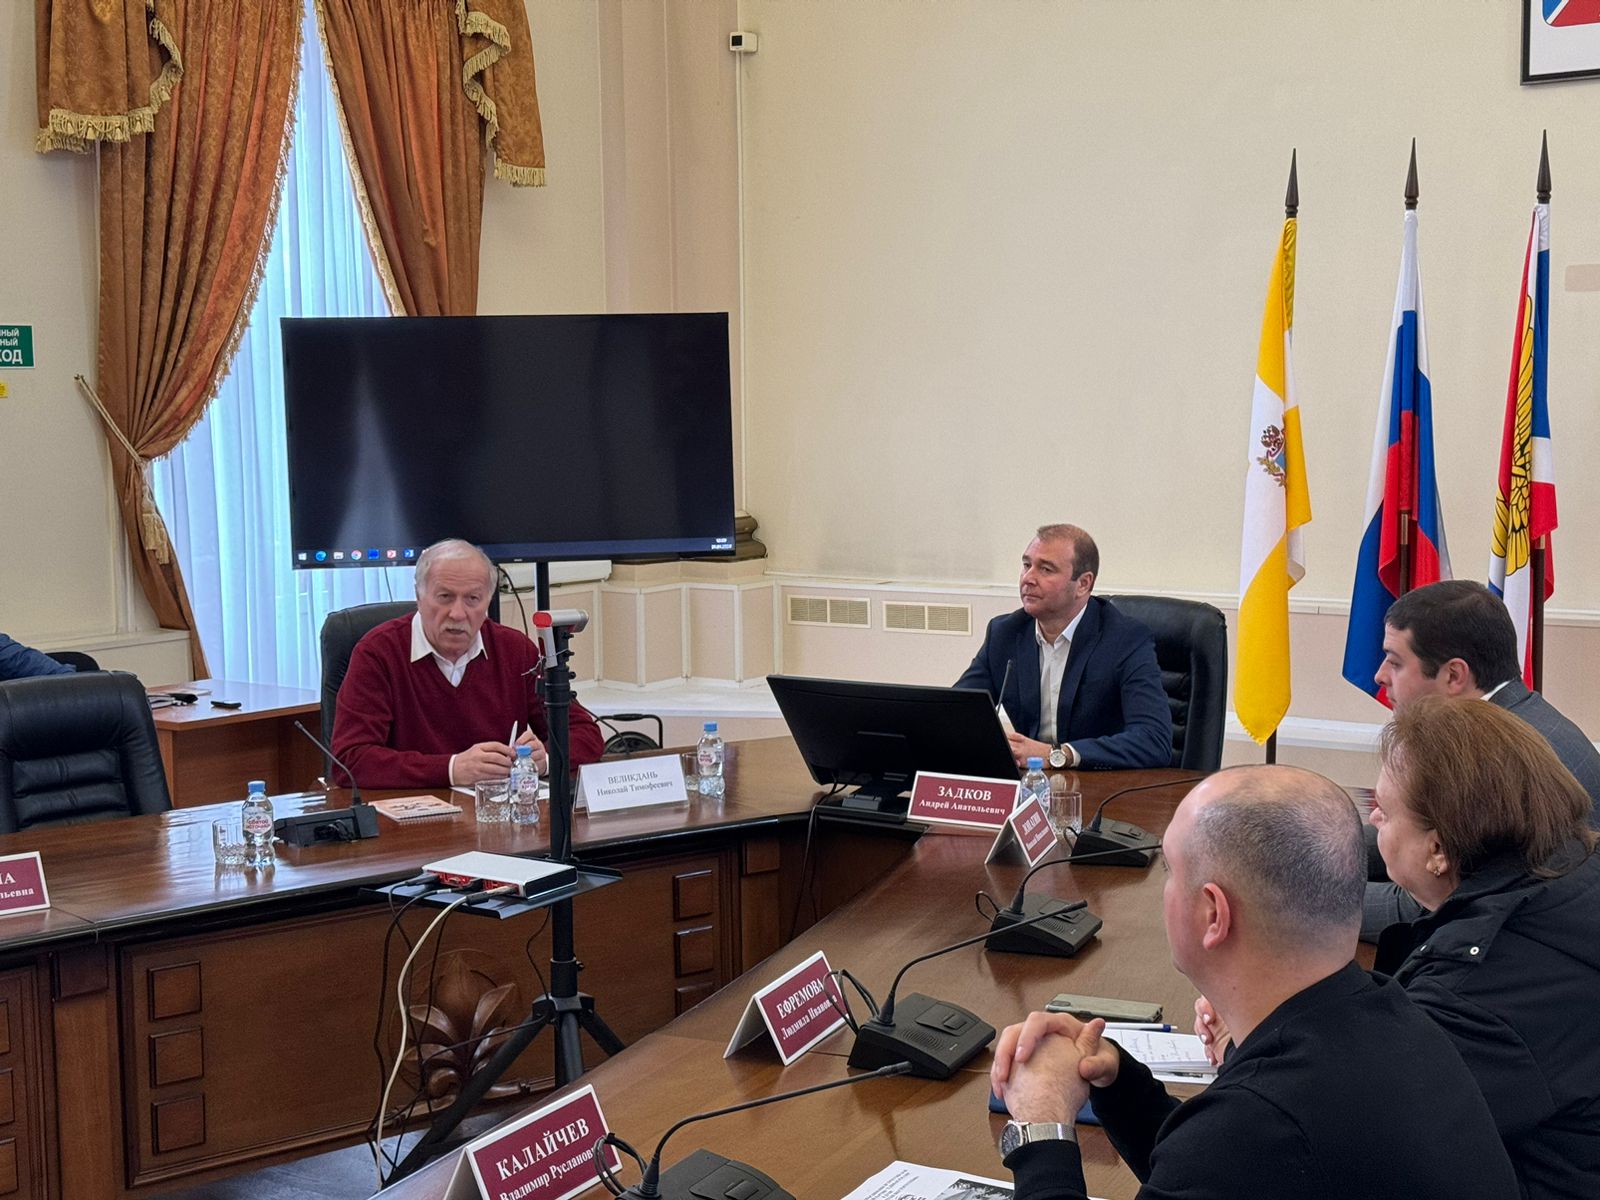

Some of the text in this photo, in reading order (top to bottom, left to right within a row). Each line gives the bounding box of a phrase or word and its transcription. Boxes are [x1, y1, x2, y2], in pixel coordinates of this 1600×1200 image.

[0, 349, 23, 364] ОД
[607, 771, 658, 784] ВЕЛИКДАНЬ
[596, 781, 673, 796] Николай Тимофеевич
[938, 786, 992, 801] ЗАДКОВ
[919, 799, 1006, 815] Андрей Анатольевич
[776, 978, 824, 1019] ЕФРЕМОВА
[781, 1015, 811, 1040] Людмила
[496, 1118, 590, 1181] КАЛАЙЧЕВ
[499, 1172, 550, 1200] Владимир
